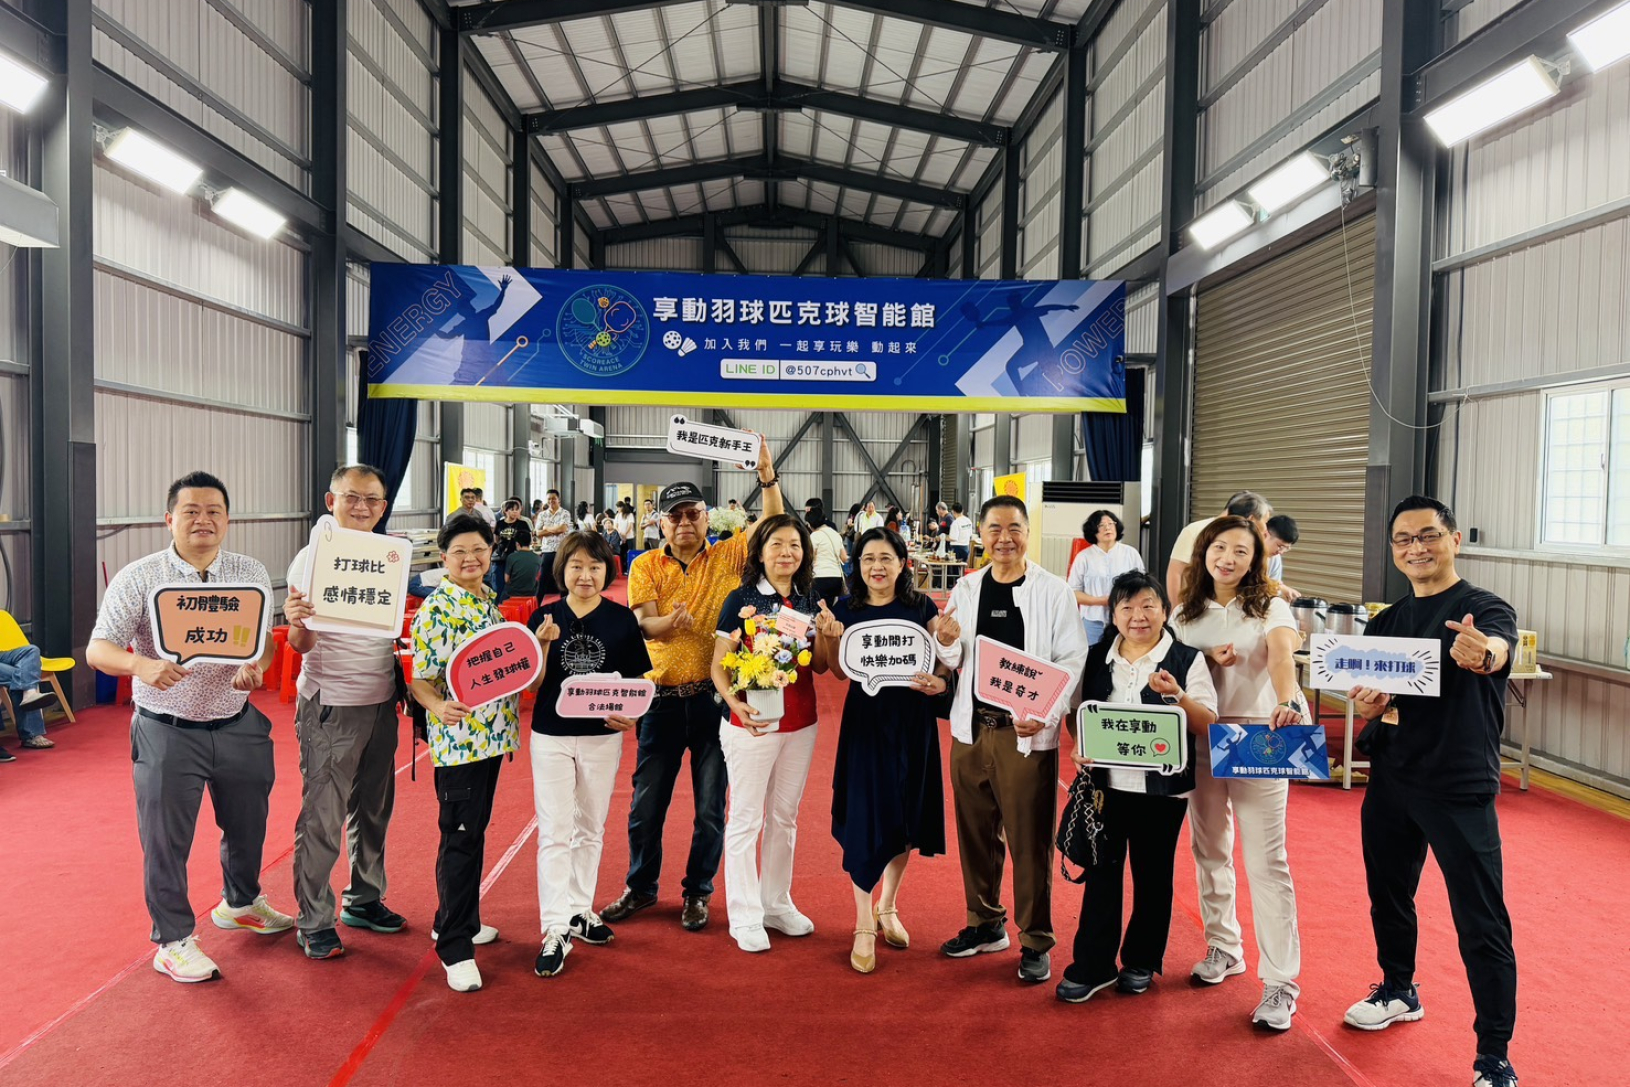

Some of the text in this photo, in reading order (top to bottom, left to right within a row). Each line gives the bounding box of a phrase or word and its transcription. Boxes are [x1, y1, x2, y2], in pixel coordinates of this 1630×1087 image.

[653, 297, 936, 328] 享動羽球匹克球智能館
[704, 337, 917, 354] 加入我們 一起享玩樂 動起來
[599, 362, 623, 372] ARENA
[725, 364, 776, 375] LINE ID
[785, 366, 853, 378] @507cphvt
[676, 429, 752, 452] 我是匹克新手王
[334, 556, 386, 574] 打球比
[176, 594, 240, 612] 初體驗
[323, 585, 392, 605] 感情穩定
[861, 634, 915, 649] 享動開打
[466, 641, 516, 668] 把握自己
[860, 653, 917, 668] 快樂加碼
[470, 657, 531, 690] 人生發球權
[990, 676, 1039, 701] 我是奇才
[588, 702, 623, 711] 合法場館
[1101, 718, 1157, 734] 我在享動
[1117, 742, 1147, 756] 等你
